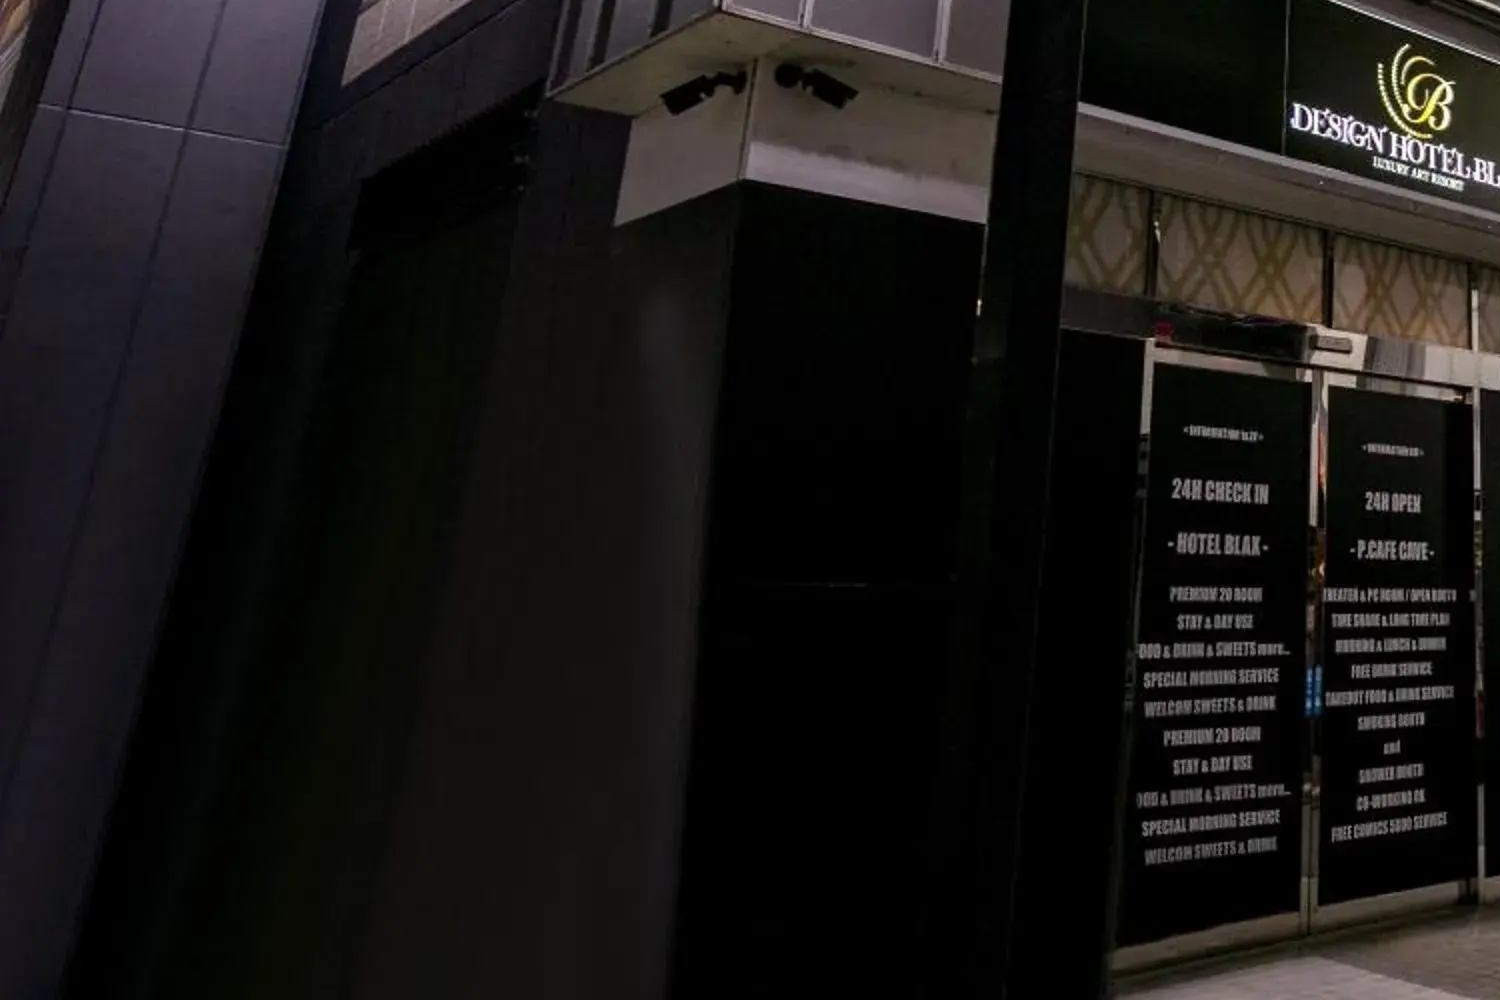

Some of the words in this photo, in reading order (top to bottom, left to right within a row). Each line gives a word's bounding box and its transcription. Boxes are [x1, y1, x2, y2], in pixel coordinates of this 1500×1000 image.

[1290, 102, 1388, 155] DESIGN
[1390, 131, 1472, 180] HOTEL
[1171, 478, 1202, 500] 24H
[1205, 480, 1251, 502] CHECK
[1253, 484, 1269, 504] IN
[1365, 492, 1390, 511] 24H
[1391, 493, 1421, 512] OPEN
[1177, 615, 1203, 629] STAY
[1235, 614, 1253, 629] USE
[1163, 646, 1170, 658] &
[1215, 642, 1256, 656] SWEETS
[1144, 672, 1187, 688] SPECIAL
[1237, 668, 1279, 683] SERVICE
[1351, 664, 1371, 678] FREE
[1194, 698, 1236, 713] SWEETS
[1163, 728, 1213, 746] PREMIUM
[1173, 759, 1199, 775] STAY
[1210, 756, 1231, 772] DAY
[1233, 755, 1252, 770] USE
[1214, 784, 1256, 800] SWEETS
[1142, 818, 1187, 836] SPECIAL
[1239, 810, 1280, 826] SERVICE
[1194, 841, 1236, 858] SWEETS
